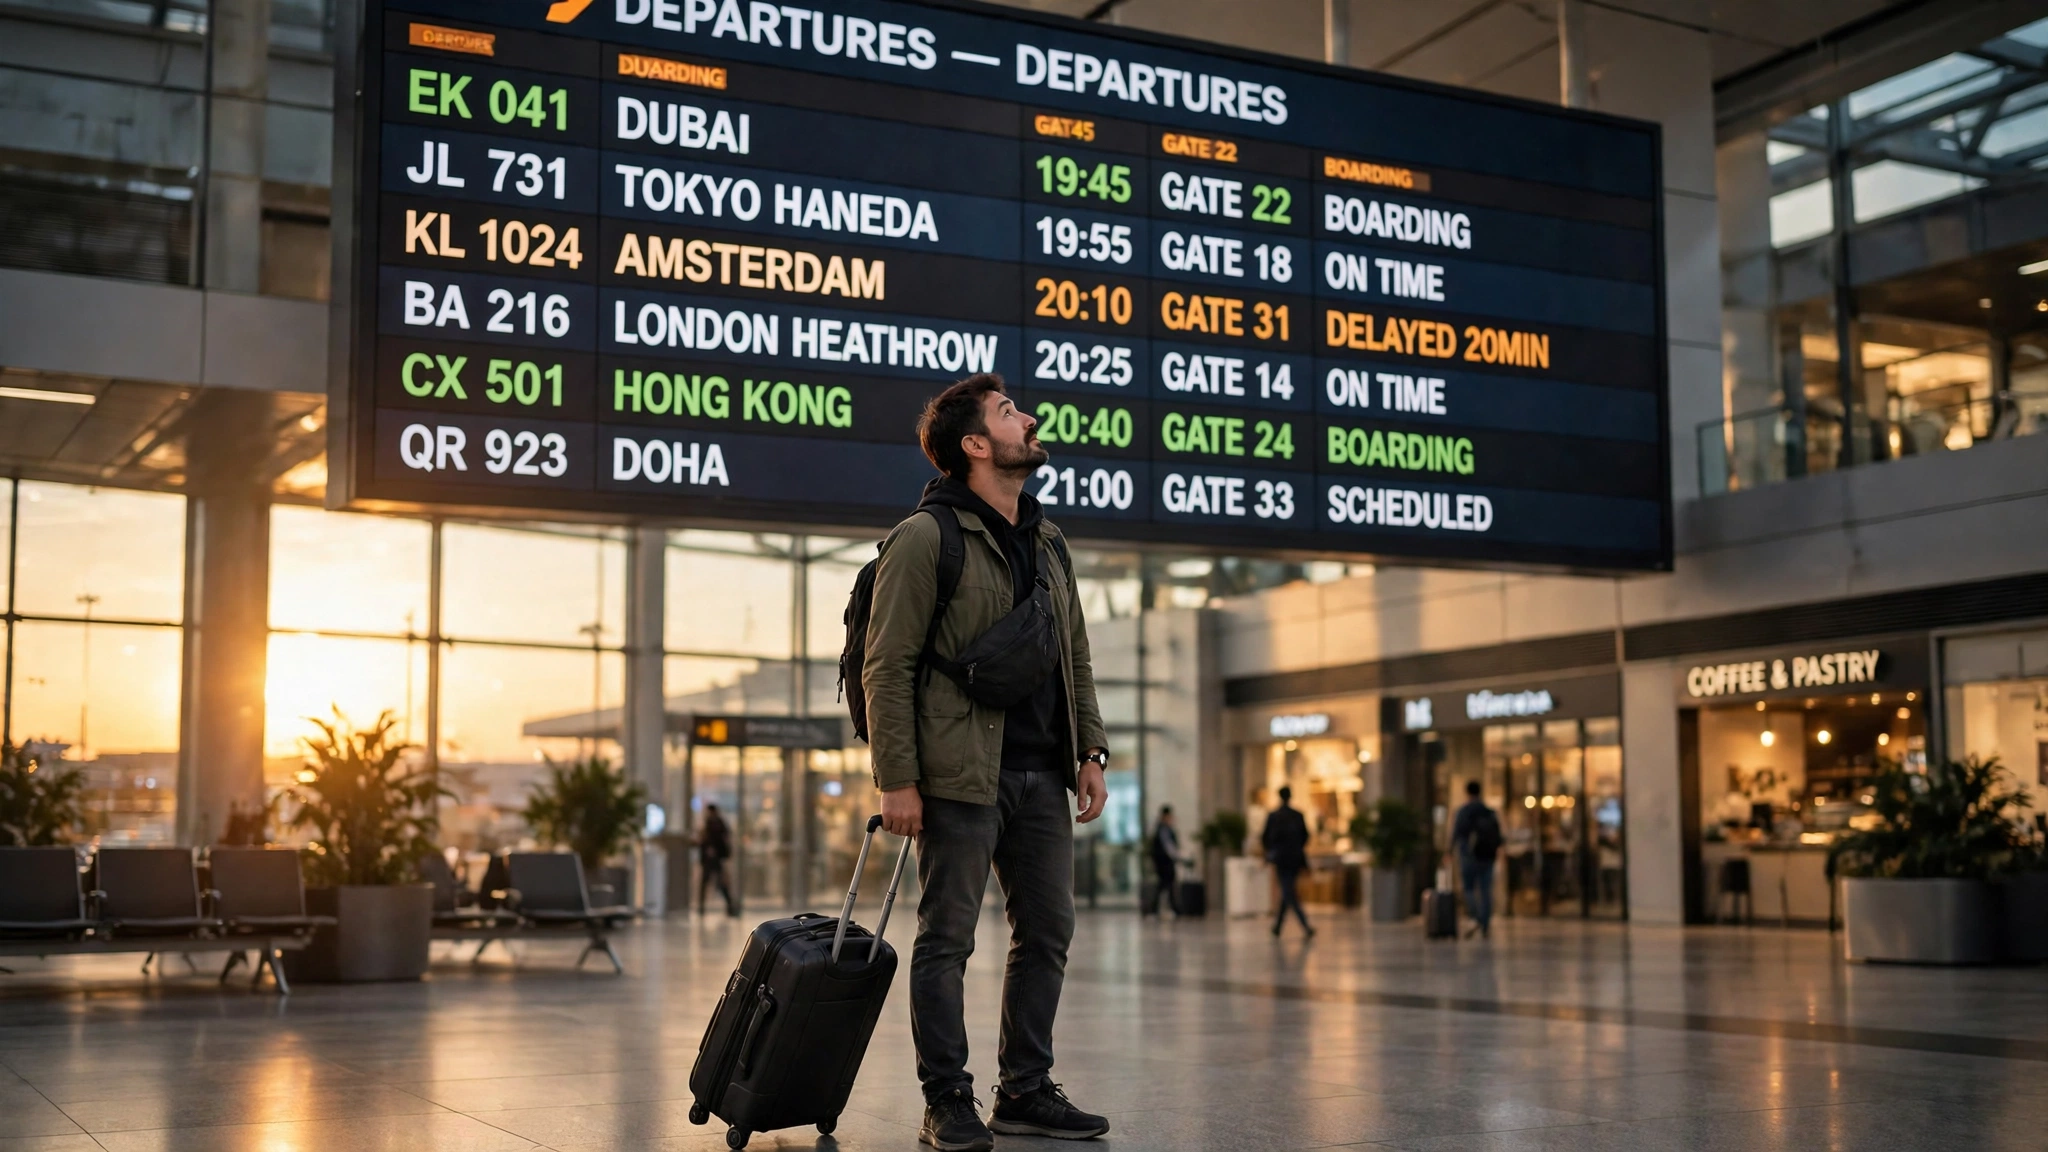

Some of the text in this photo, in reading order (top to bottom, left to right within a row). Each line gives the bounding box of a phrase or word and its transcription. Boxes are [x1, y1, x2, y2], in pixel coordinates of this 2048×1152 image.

[615, 0, 938, 70] DEPARTURES
[1016, 44, 1288, 125] DEPARTURES
[410, 69, 1471, 248] EK 041 DUBAI 19:45 GATE 22 BOARDING
[1163, 134, 1237, 162] GATE 22
[1325, 157, 1413, 188] BOARDING
[407, 141, 1444, 301] JL 731 TOKYO HANEDA 19:55 GATE 18 ON TIME
[405, 281, 1446, 414] BA 216 LONDON HEATHROW 20:25 GATE 14 ON TIME
[406, 210, 1548, 368] KL 1024 AMSTERDAM 20:10 GATE 31 DELAYED 20MIN
[402, 353, 1473, 474] CX 501 HONG KONG 20:40 GATE 24 BOARDING
[401, 424, 1492, 531] QR 923 DOHA 21:00 GATE 33 SCHEDULED
[1687, 649, 1879, 698] COFFEE & PASTRY
